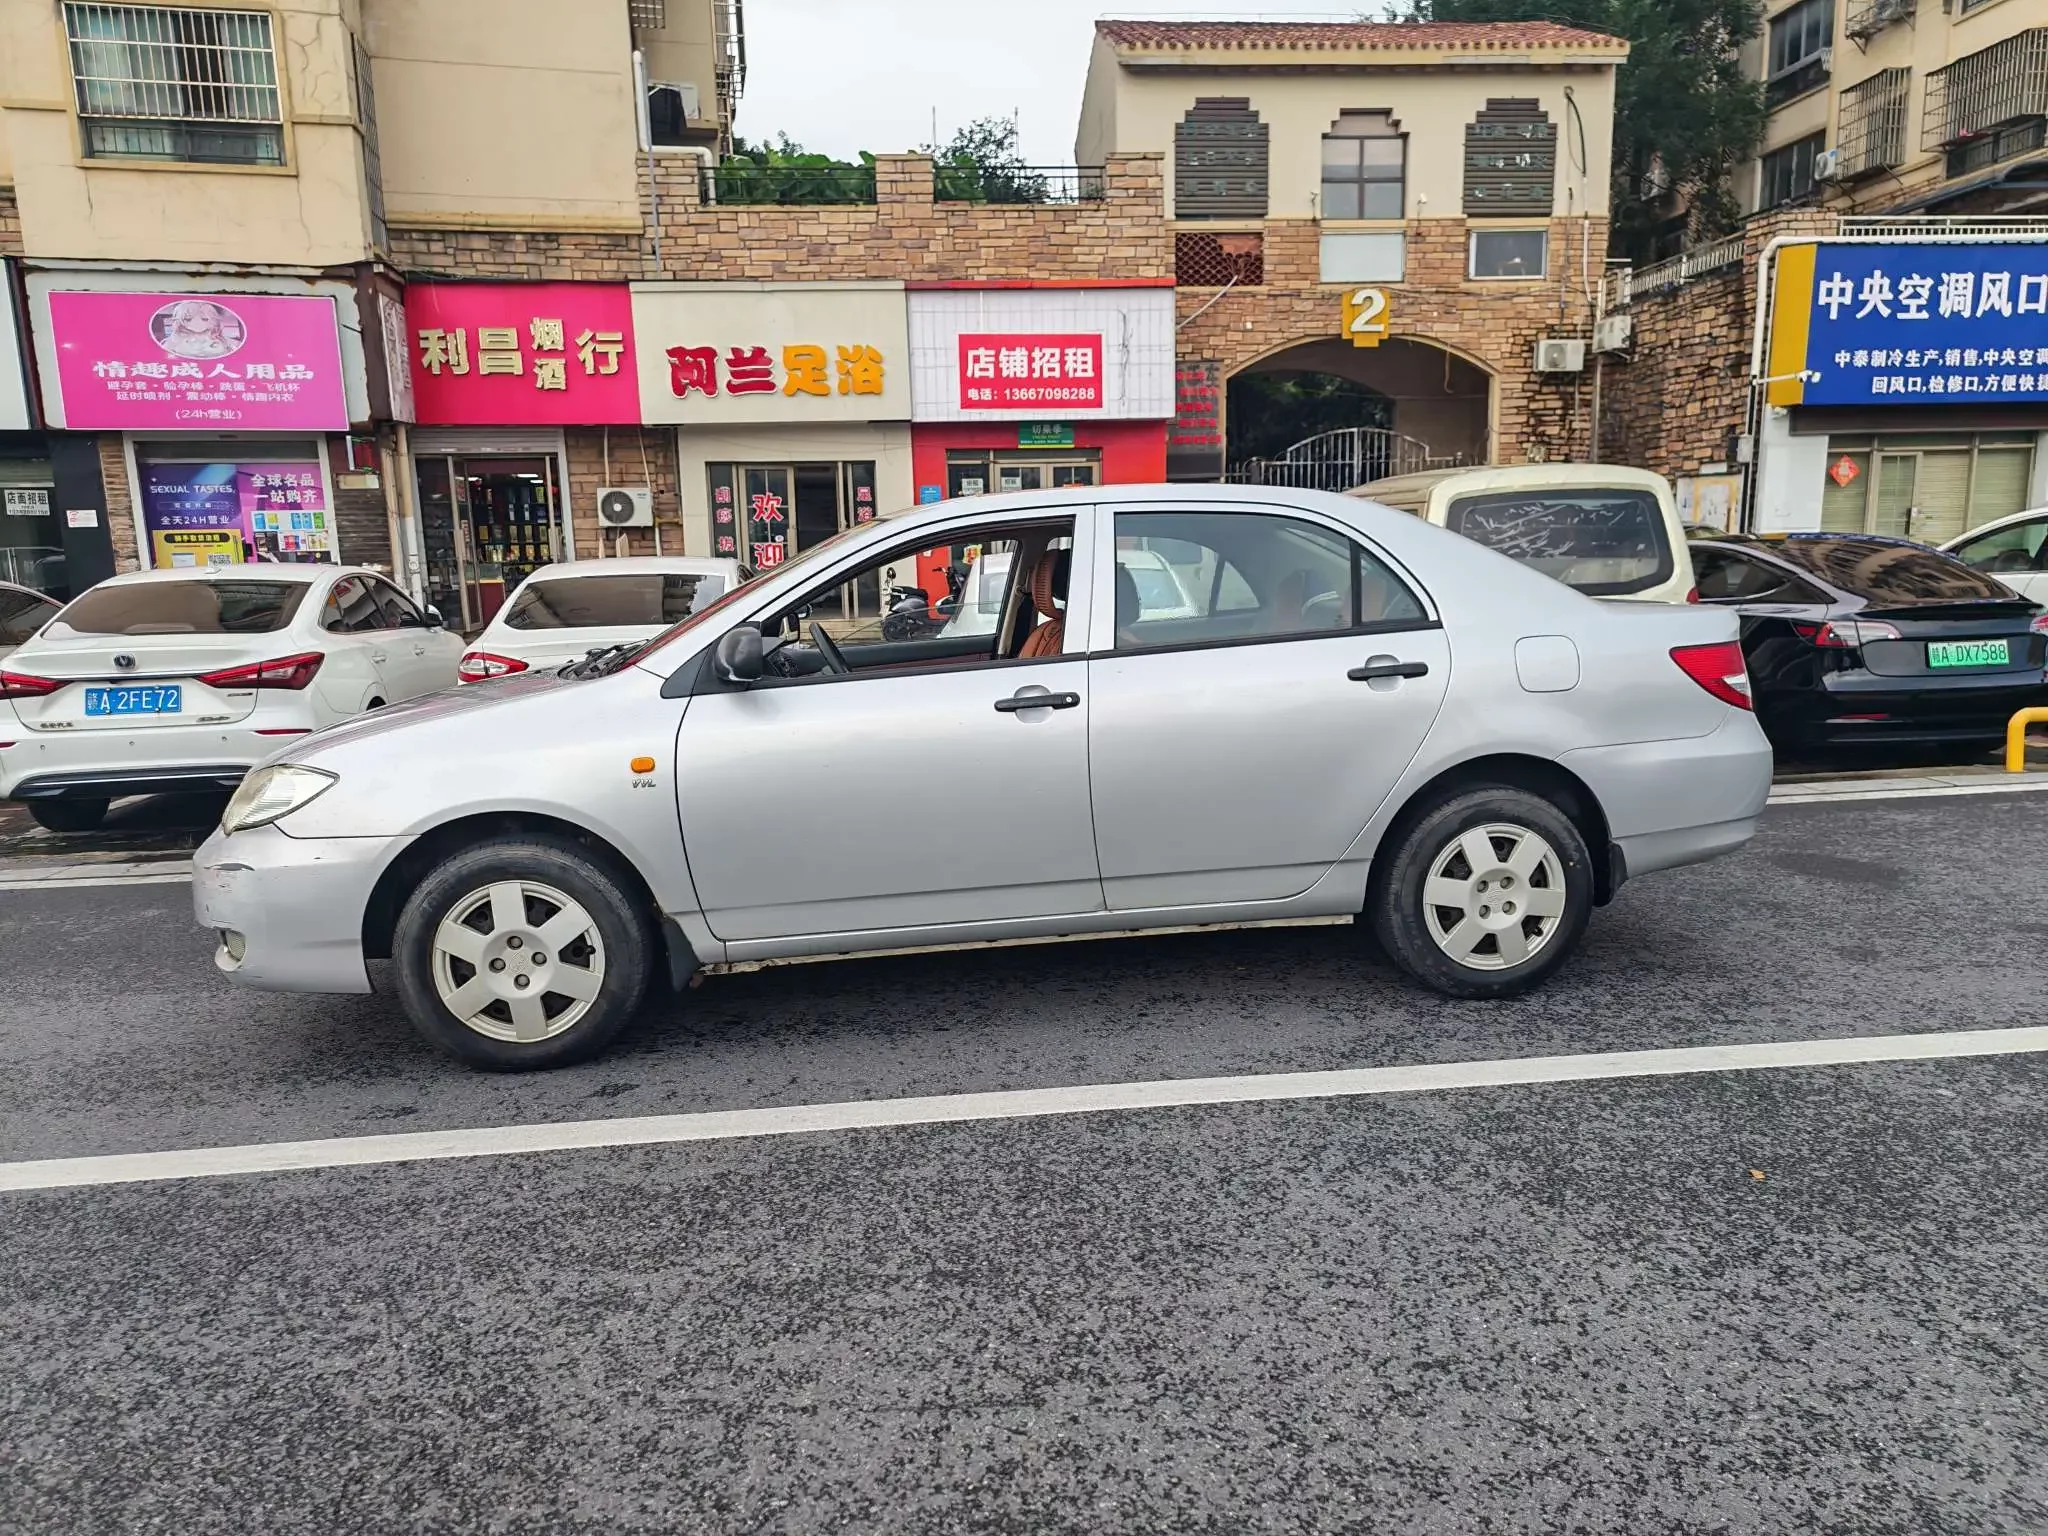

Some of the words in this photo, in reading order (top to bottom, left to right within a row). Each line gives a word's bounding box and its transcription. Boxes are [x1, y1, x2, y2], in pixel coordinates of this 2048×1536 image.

[1817, 269, 2048, 321] 中央空调风口
[1349, 288, 1387, 333] 2
[418, 316, 625, 392] 利昌烟酒行
[966, 346, 1095, 379] 店铺招租
[93, 360, 314, 380] 情趣成人用品
[665, 345, 885, 398] 阿兰足浴
[150, 485, 190, 494] SEXUAL
[250, 473, 315, 488] 全球名品
[7, 492, 48, 505] 店面招租
[253, 488, 318, 504] 一站购齐
[160, 515, 231, 526] 全天24H营业
[752, 491, 785, 570] 欢迎
